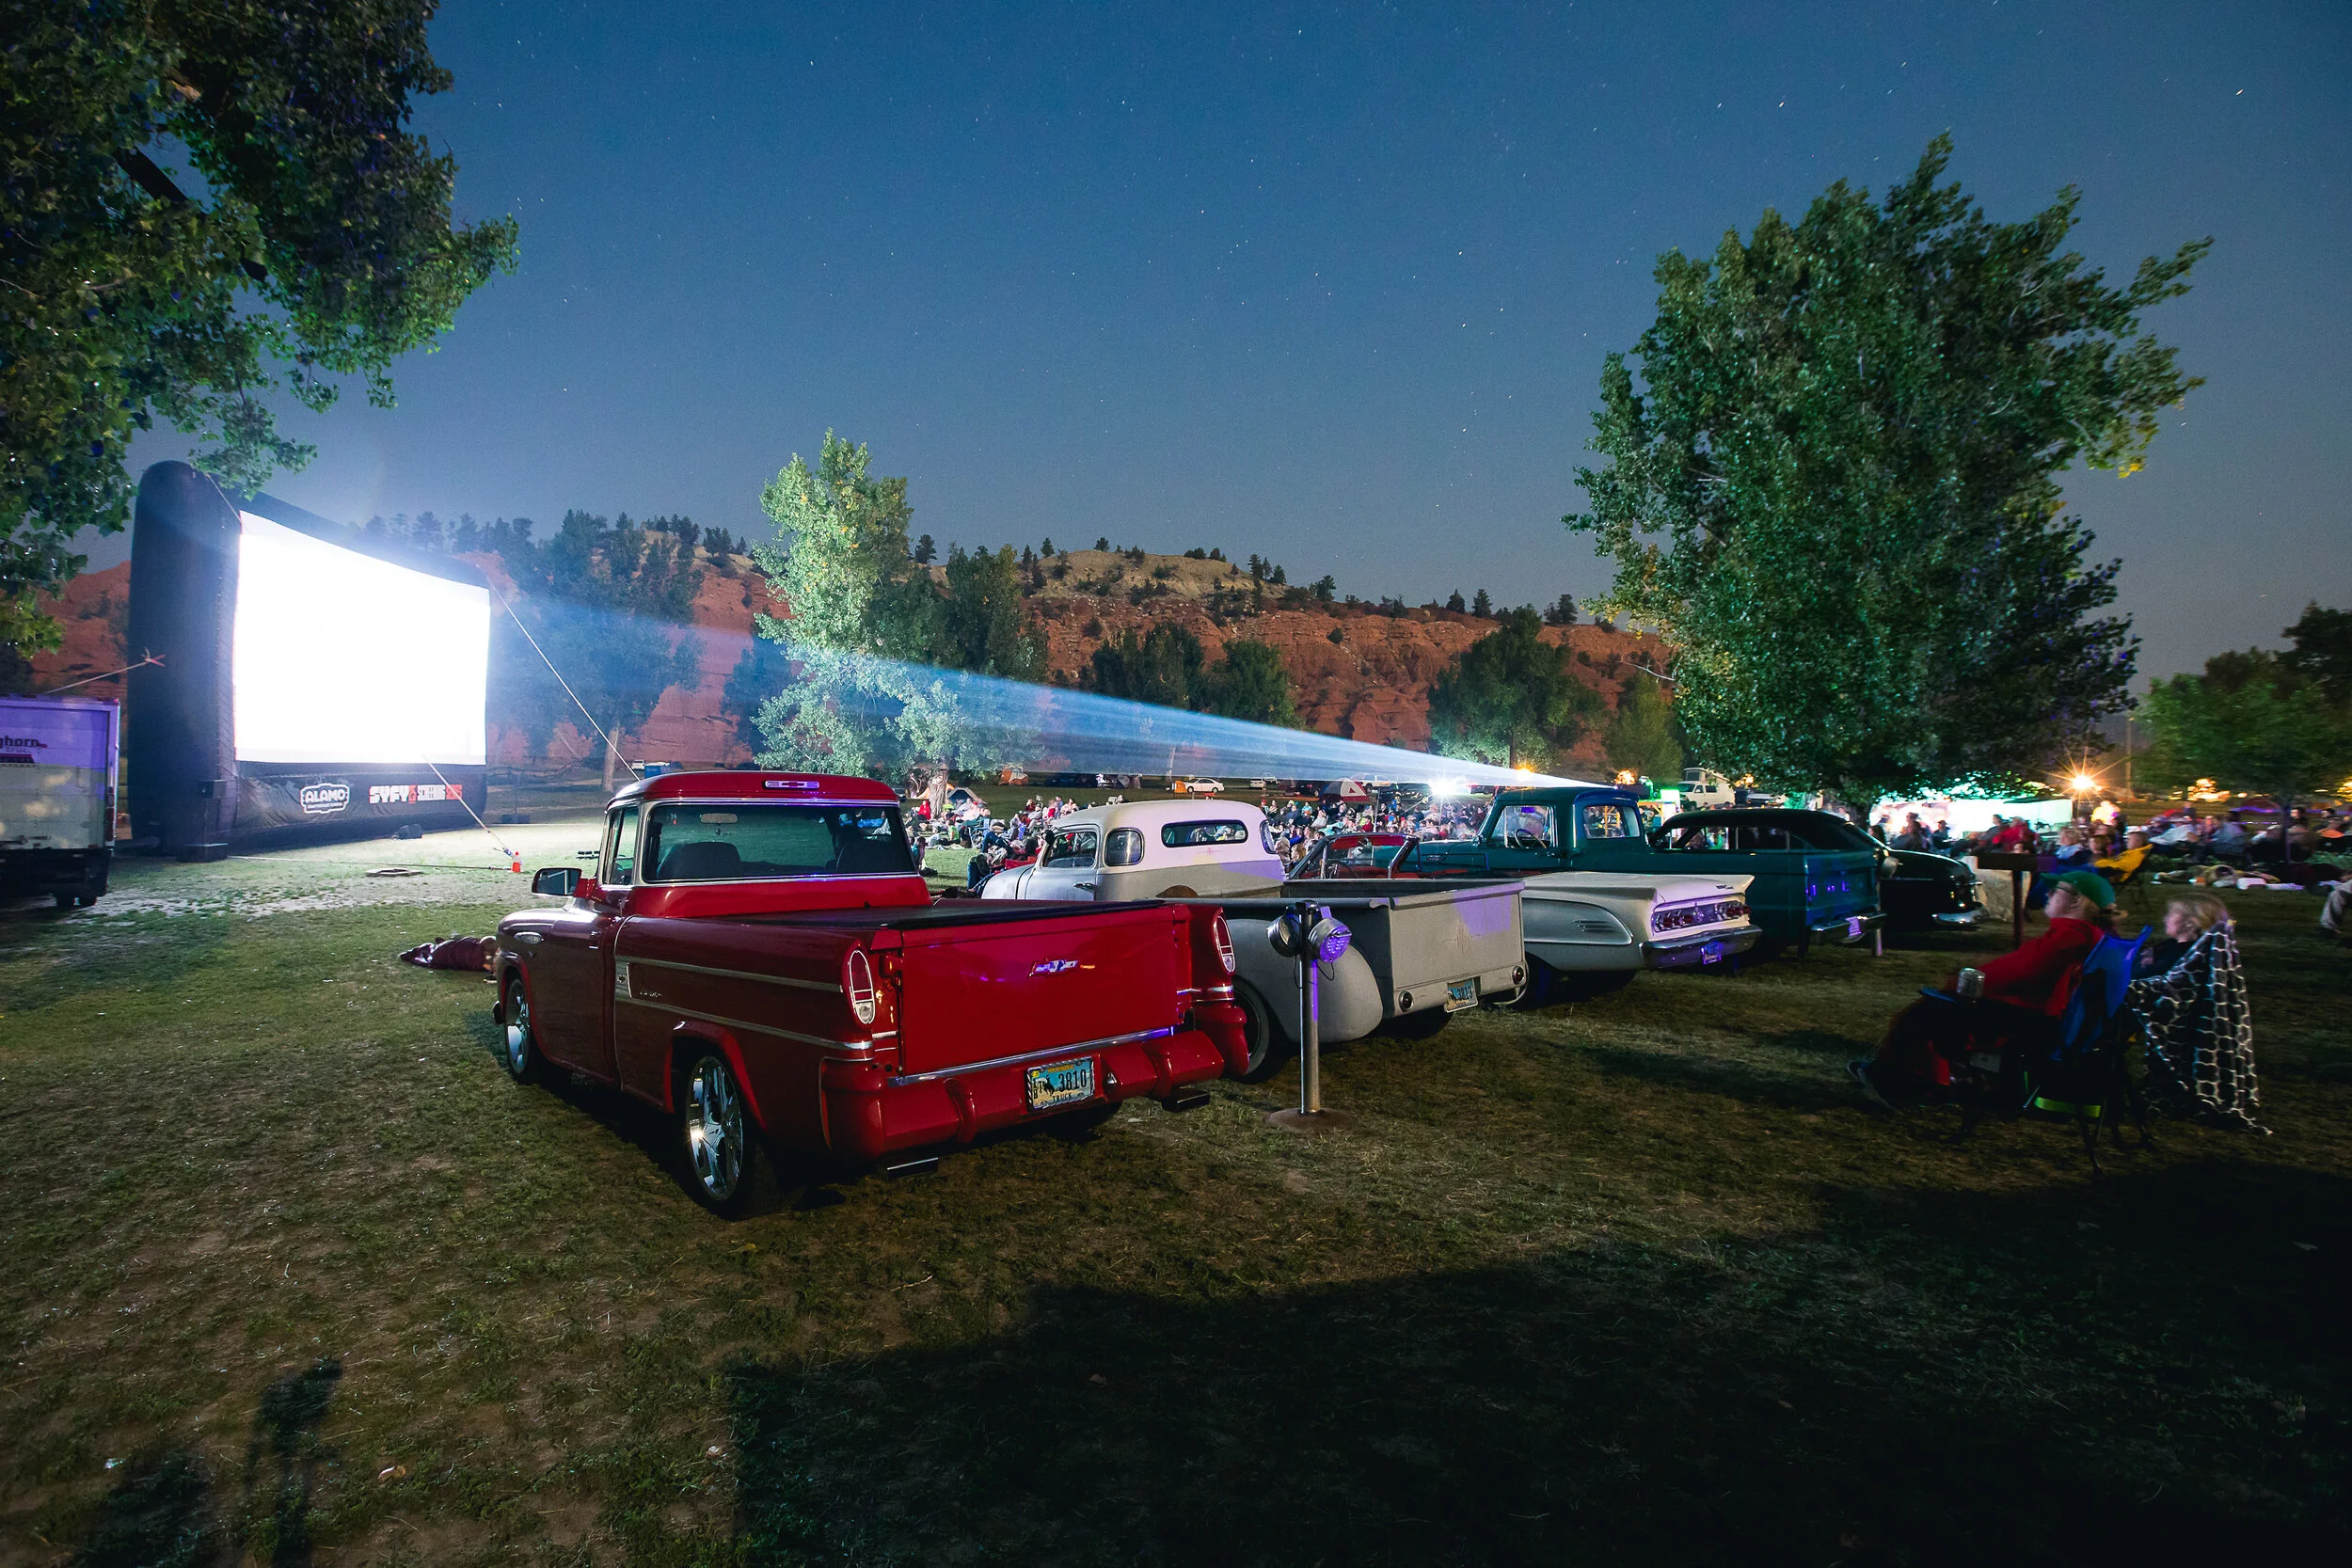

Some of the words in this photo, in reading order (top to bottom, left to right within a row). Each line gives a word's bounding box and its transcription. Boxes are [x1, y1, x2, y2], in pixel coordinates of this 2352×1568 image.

[305, 789, 345, 802] ALAMO
[370, 785, 409, 804] SYFY
[1058, 1069, 1087, 1092] 3810
[1053, 1093, 1073, 1102] TRUCK
